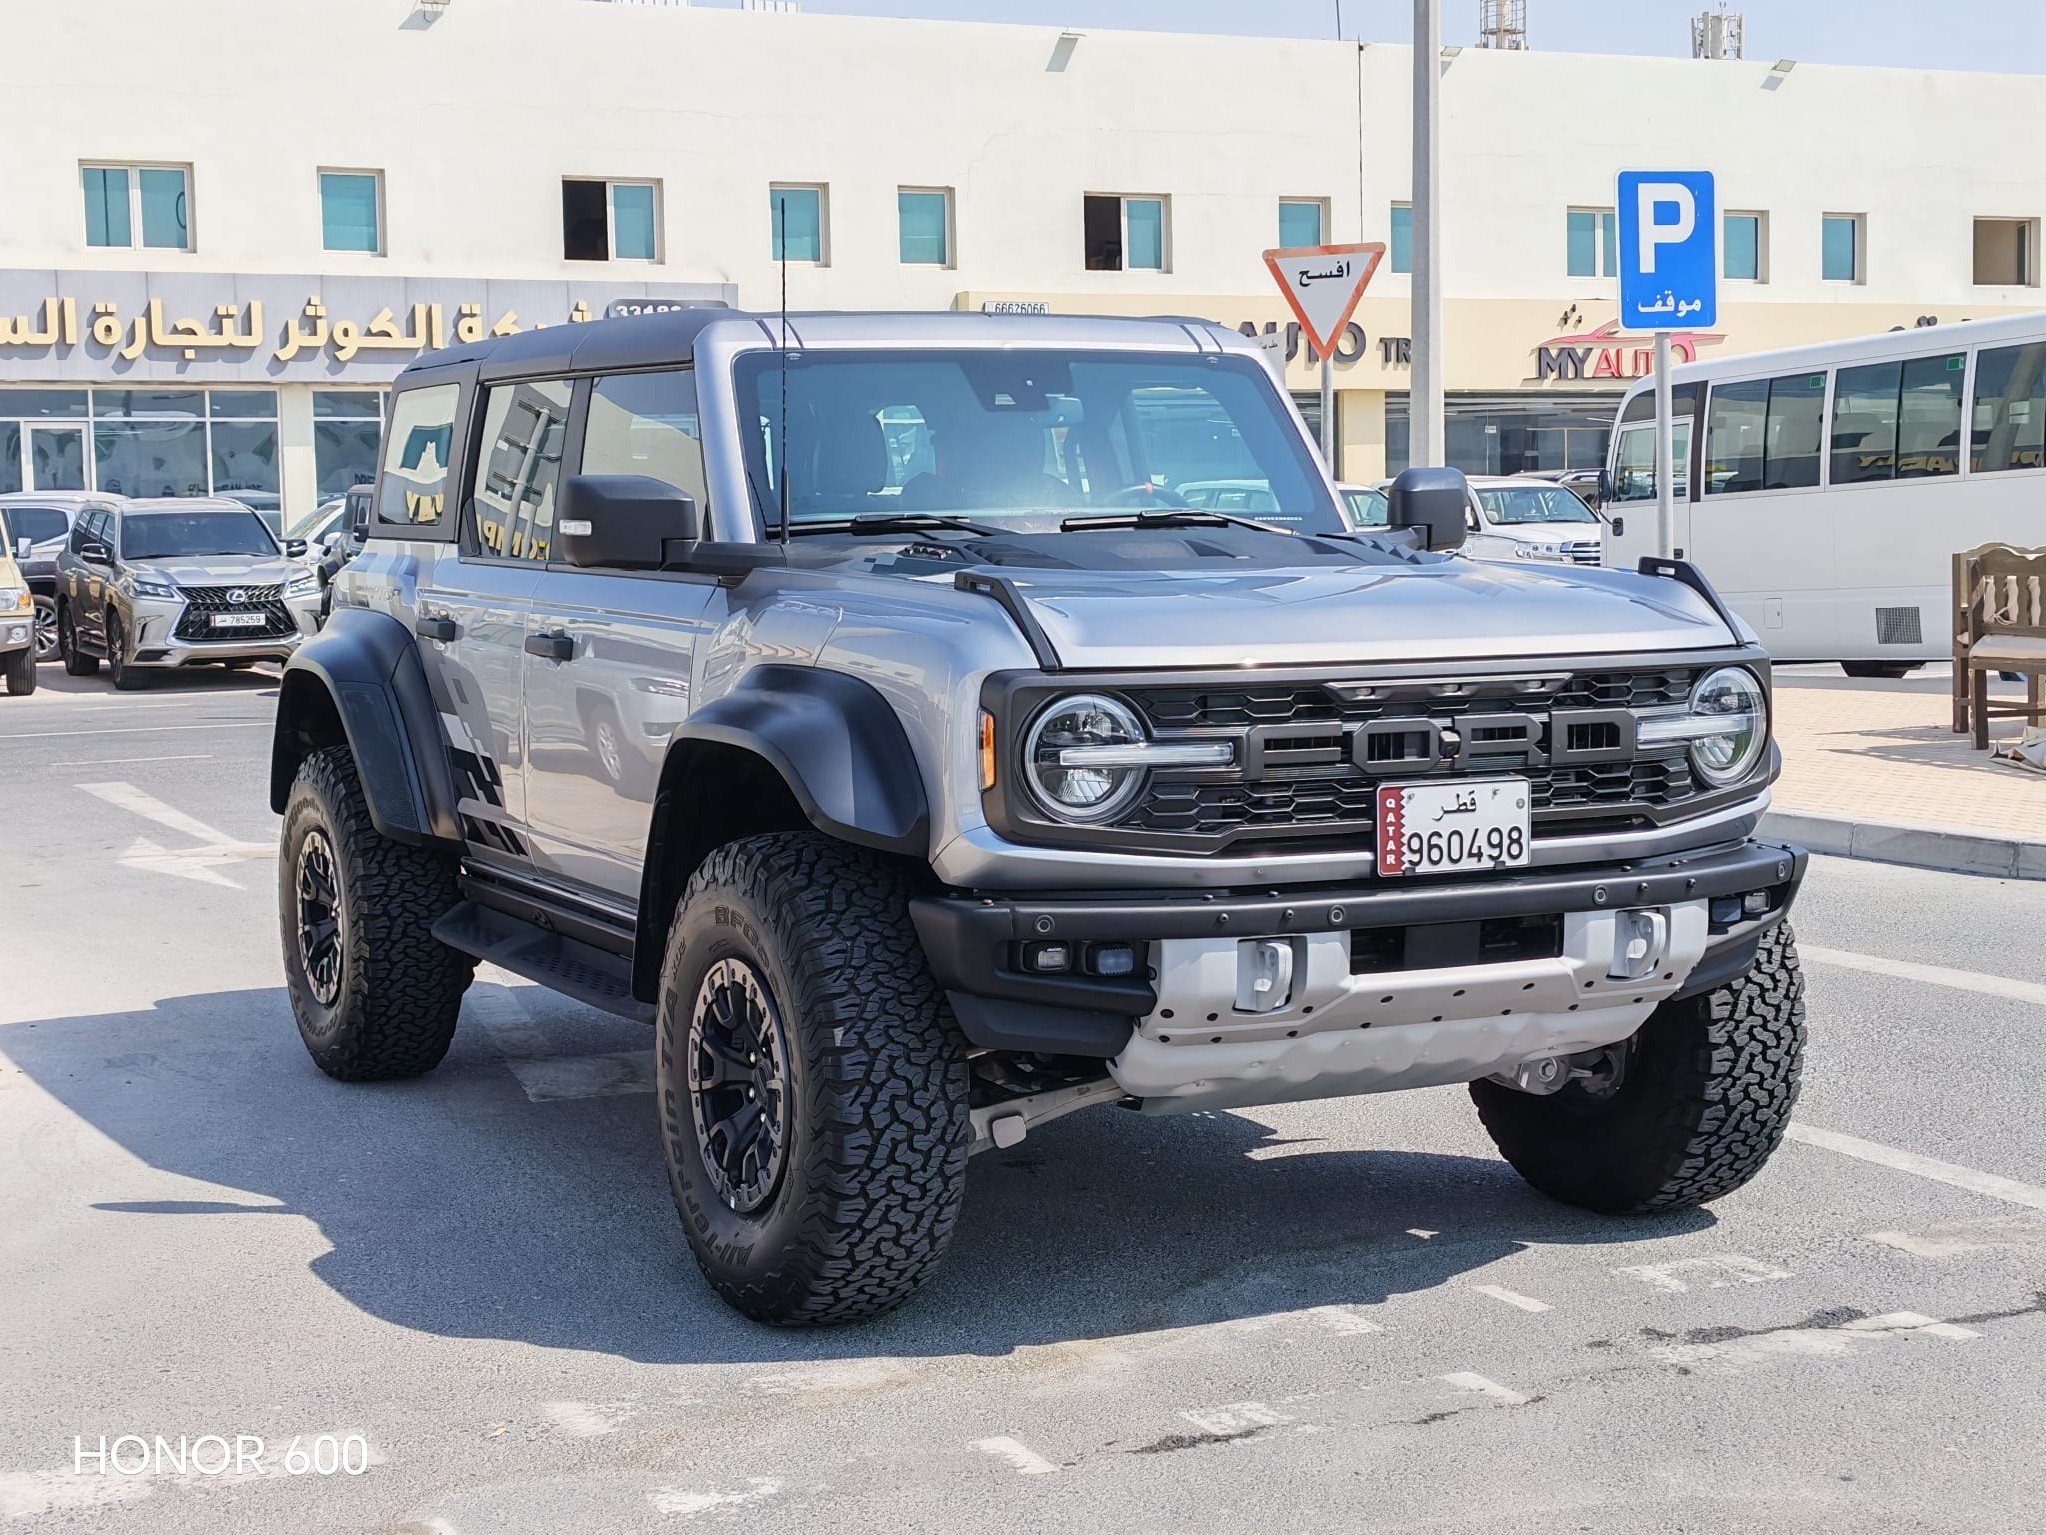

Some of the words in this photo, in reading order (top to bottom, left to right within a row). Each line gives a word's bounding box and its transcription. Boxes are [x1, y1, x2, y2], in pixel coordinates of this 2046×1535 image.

[1637, 183, 1696, 274] P
[1298, 260, 1351, 287] افسح
[1637, 290, 1702, 318] موقف
[93, 297, 263, 360] لتجارة
[274, 295, 443, 361] الكوثر
[1235, 321, 1367, 363] UO
[230, 615, 262, 625] 785259
[1243, 708, 1636, 782] FORD
[1431, 789, 1477, 822] قطر
[1385, 798, 1397, 866] QATAR
[1406, 825, 1524, 867] 960498
